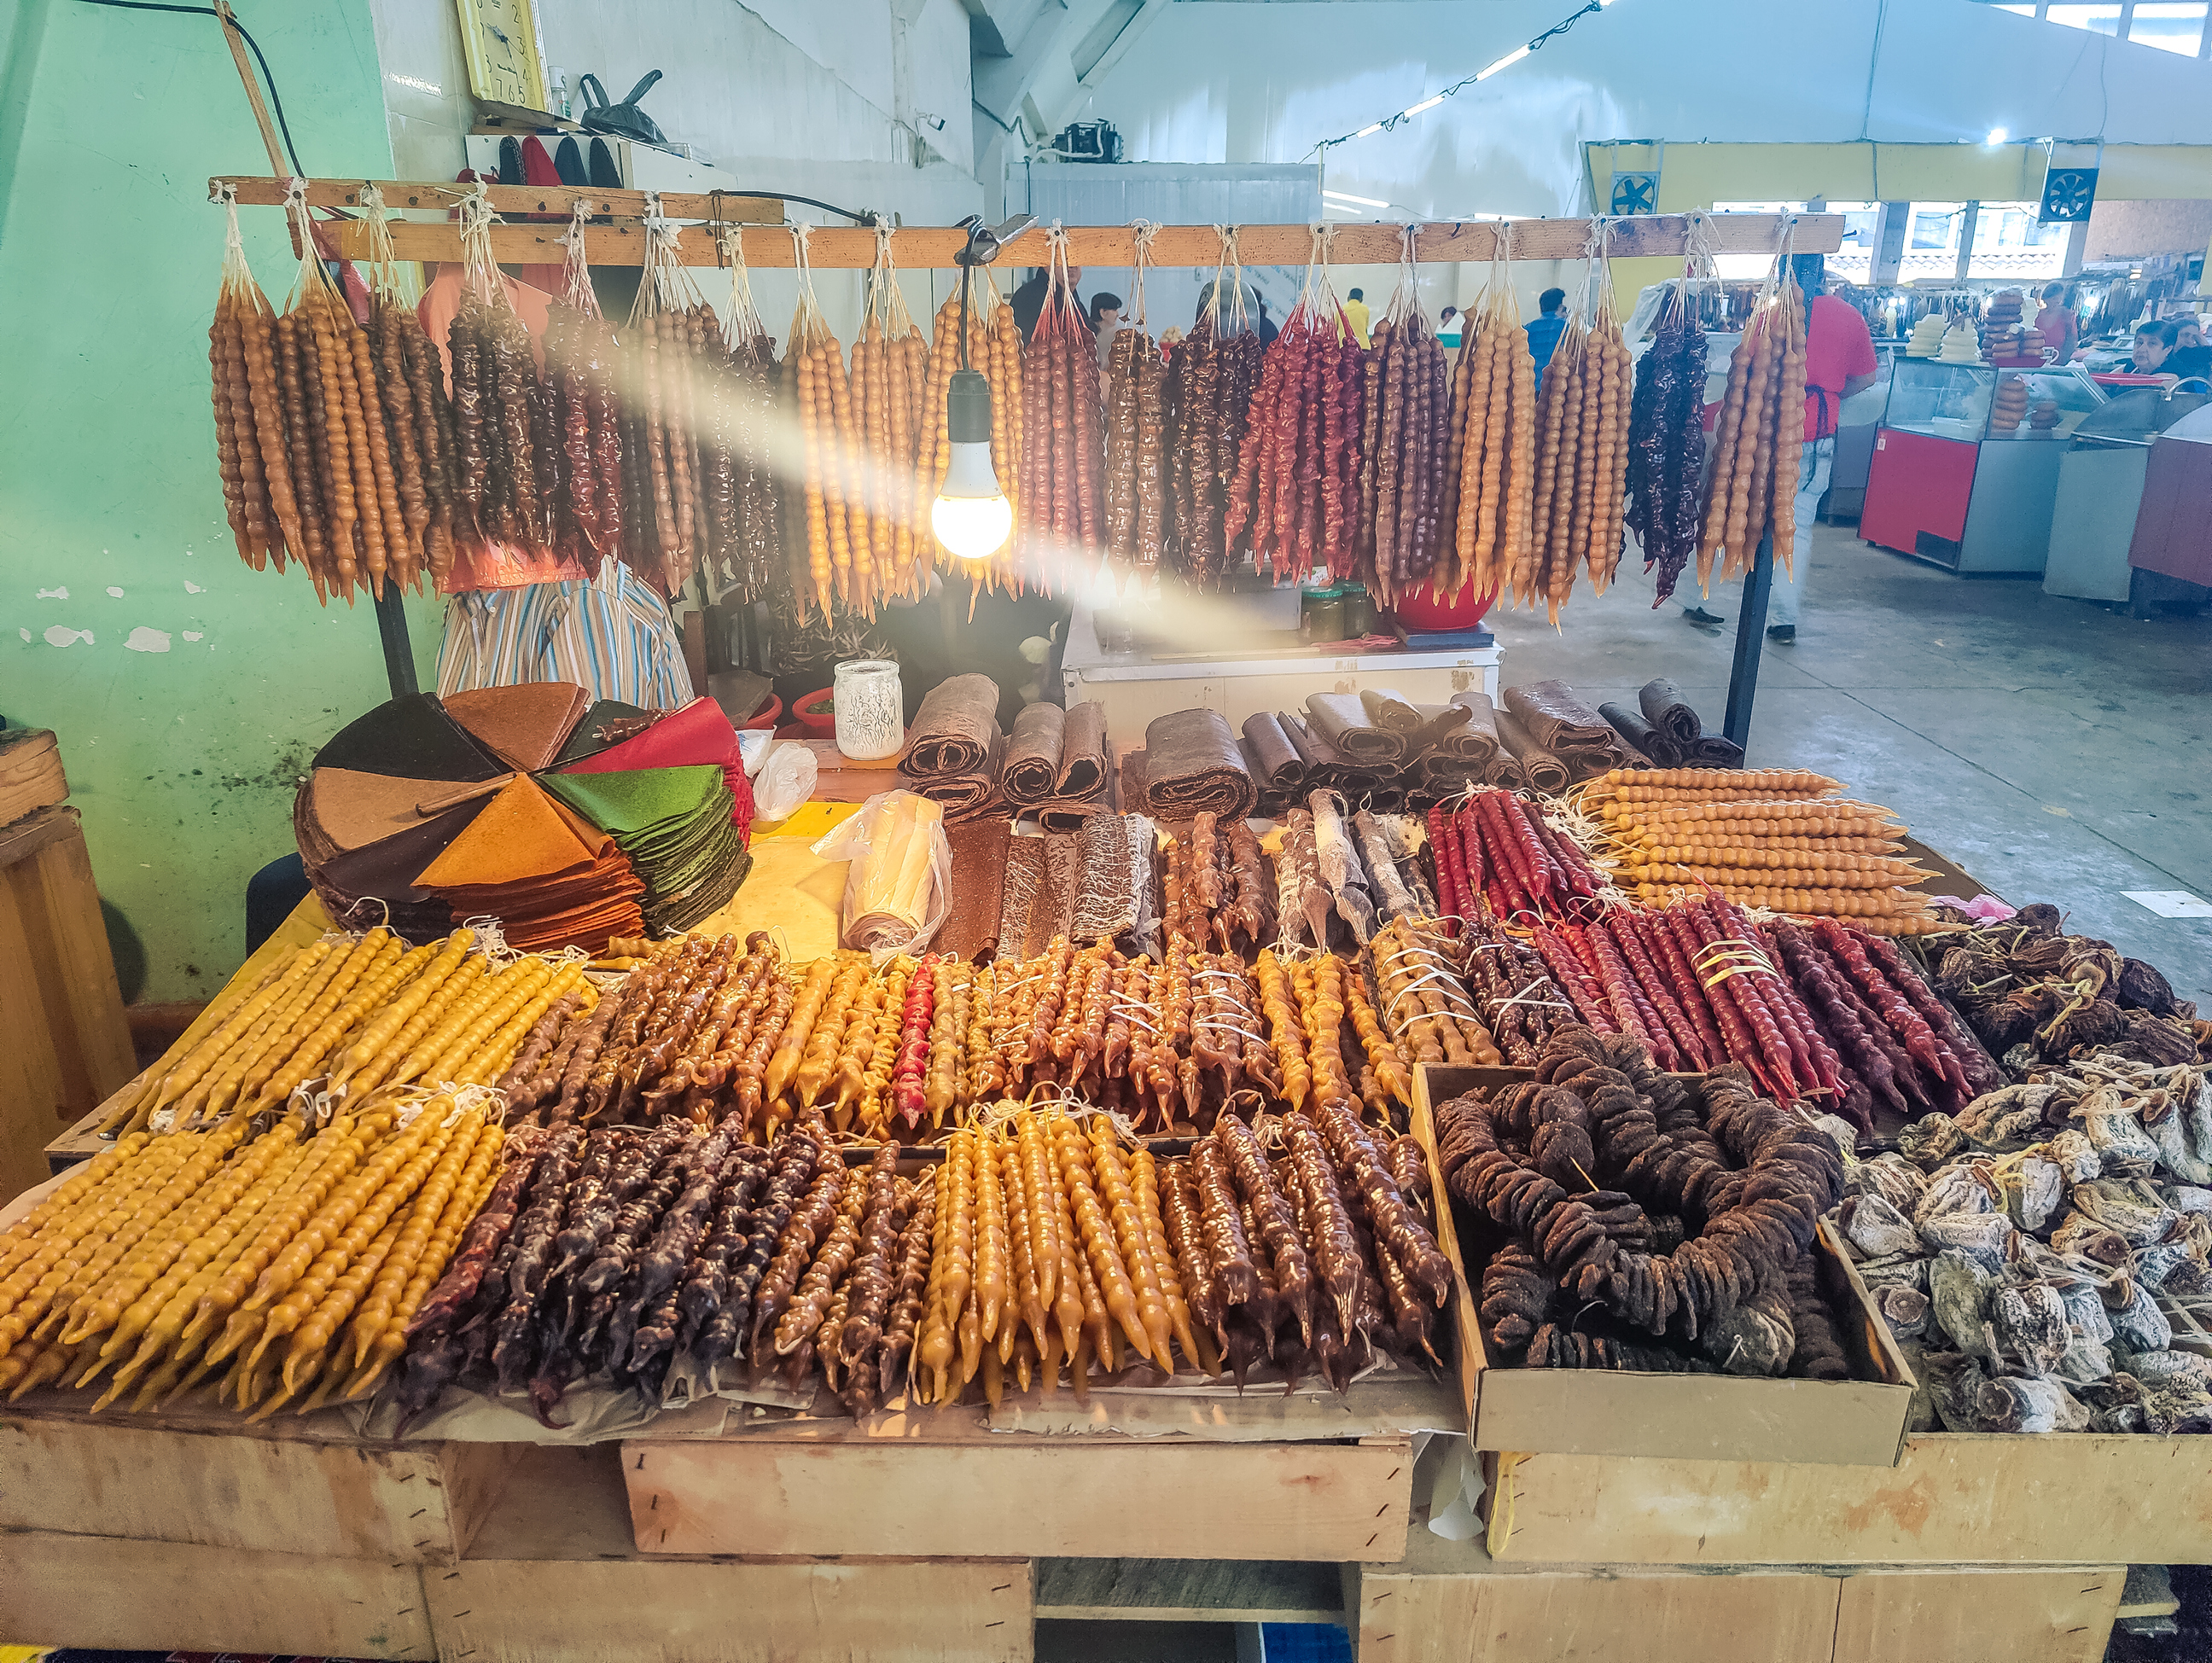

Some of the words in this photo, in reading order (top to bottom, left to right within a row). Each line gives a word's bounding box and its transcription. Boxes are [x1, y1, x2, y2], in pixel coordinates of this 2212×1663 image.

[512, 4, 519, 24] 2
[516, 36, 525, 55] 3
[496, 78, 502, 97] 7
[509, 84, 515, 102] 6
[518, 85, 525, 103] 5
